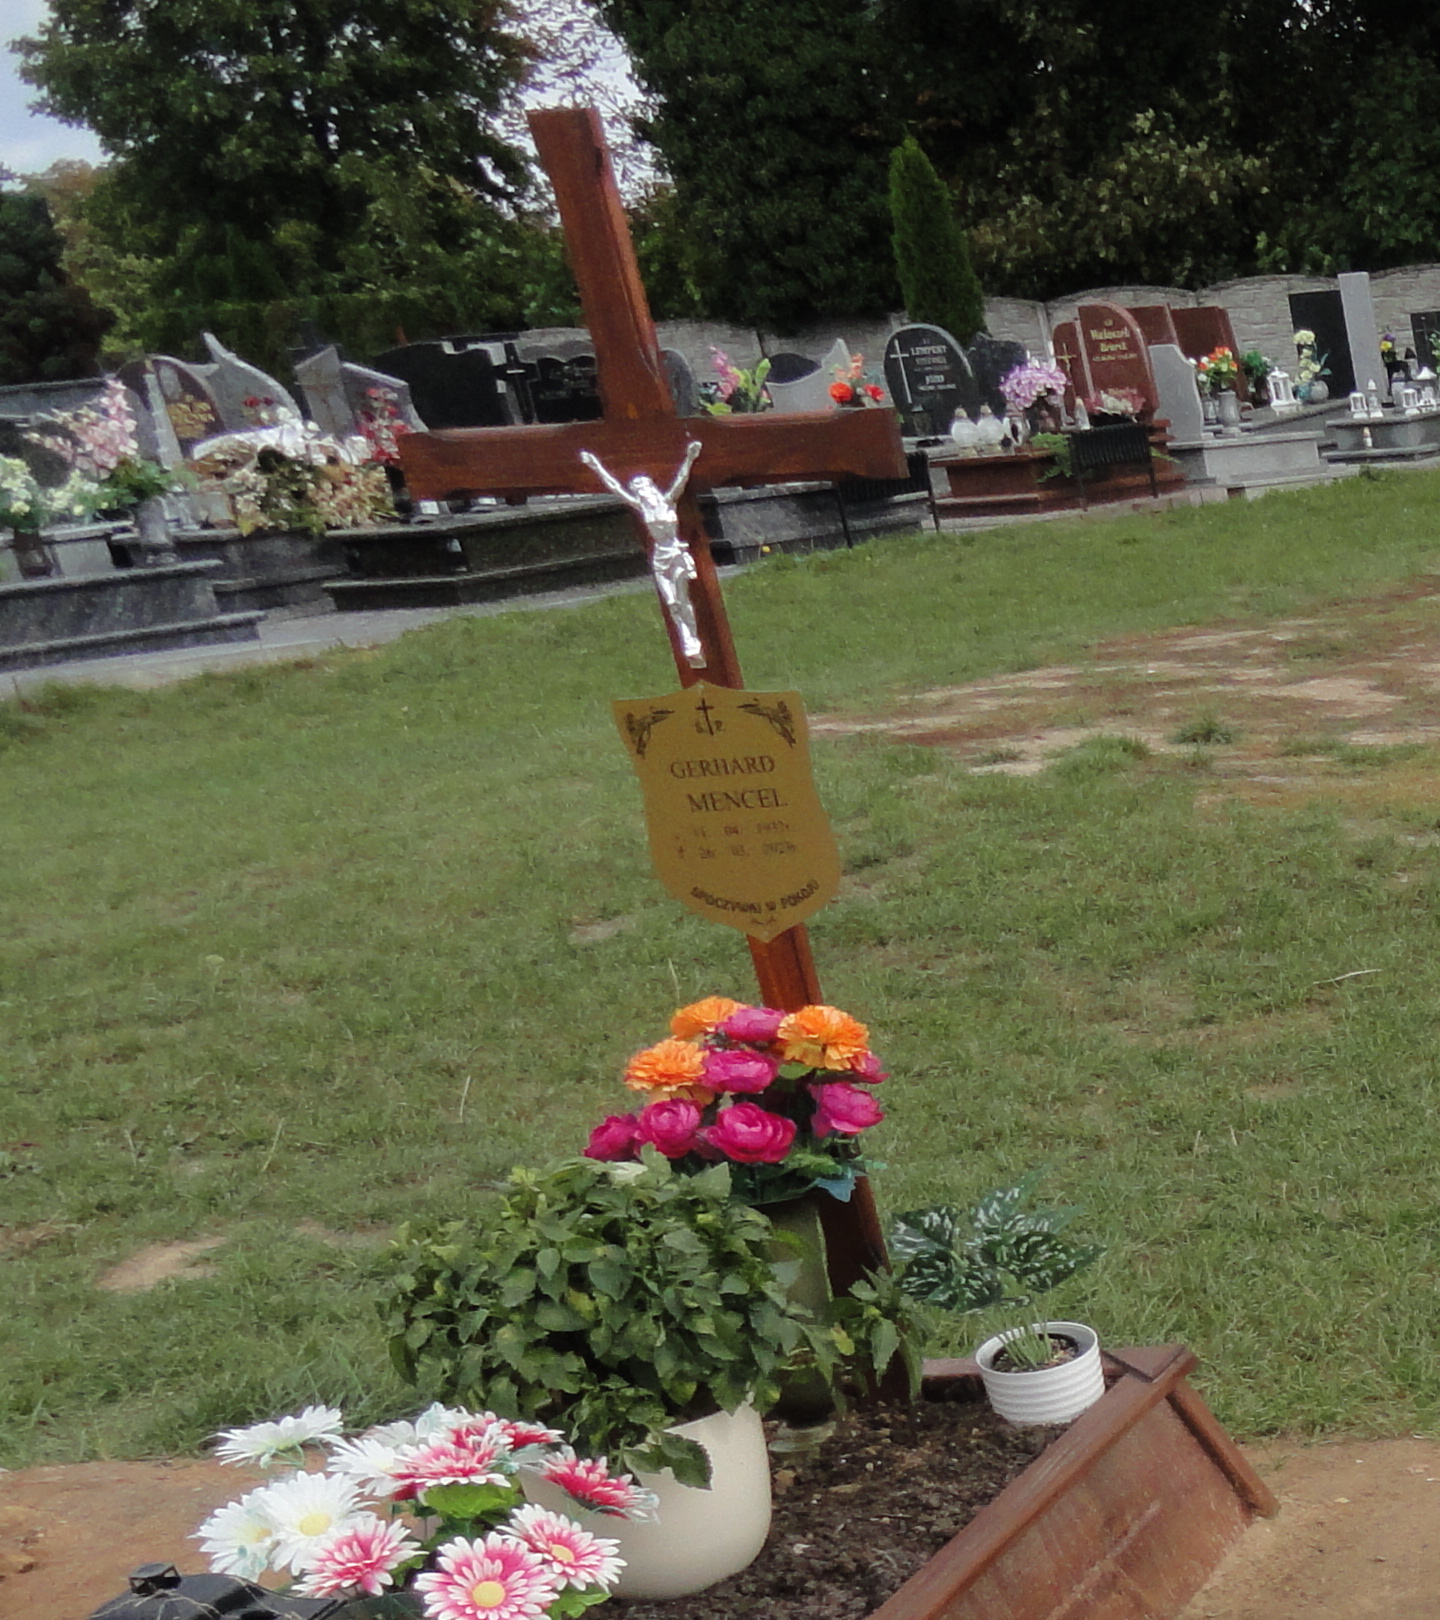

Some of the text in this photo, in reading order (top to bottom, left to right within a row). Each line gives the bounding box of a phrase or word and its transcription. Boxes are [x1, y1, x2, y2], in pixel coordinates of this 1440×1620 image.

[669, 755, 776, 780] GERHARD
[687, 787, 788, 813] MENCEL
[690, 886, 762, 914] SPOCZYWAJ
[780, 879, 820, 910] POKOJU
